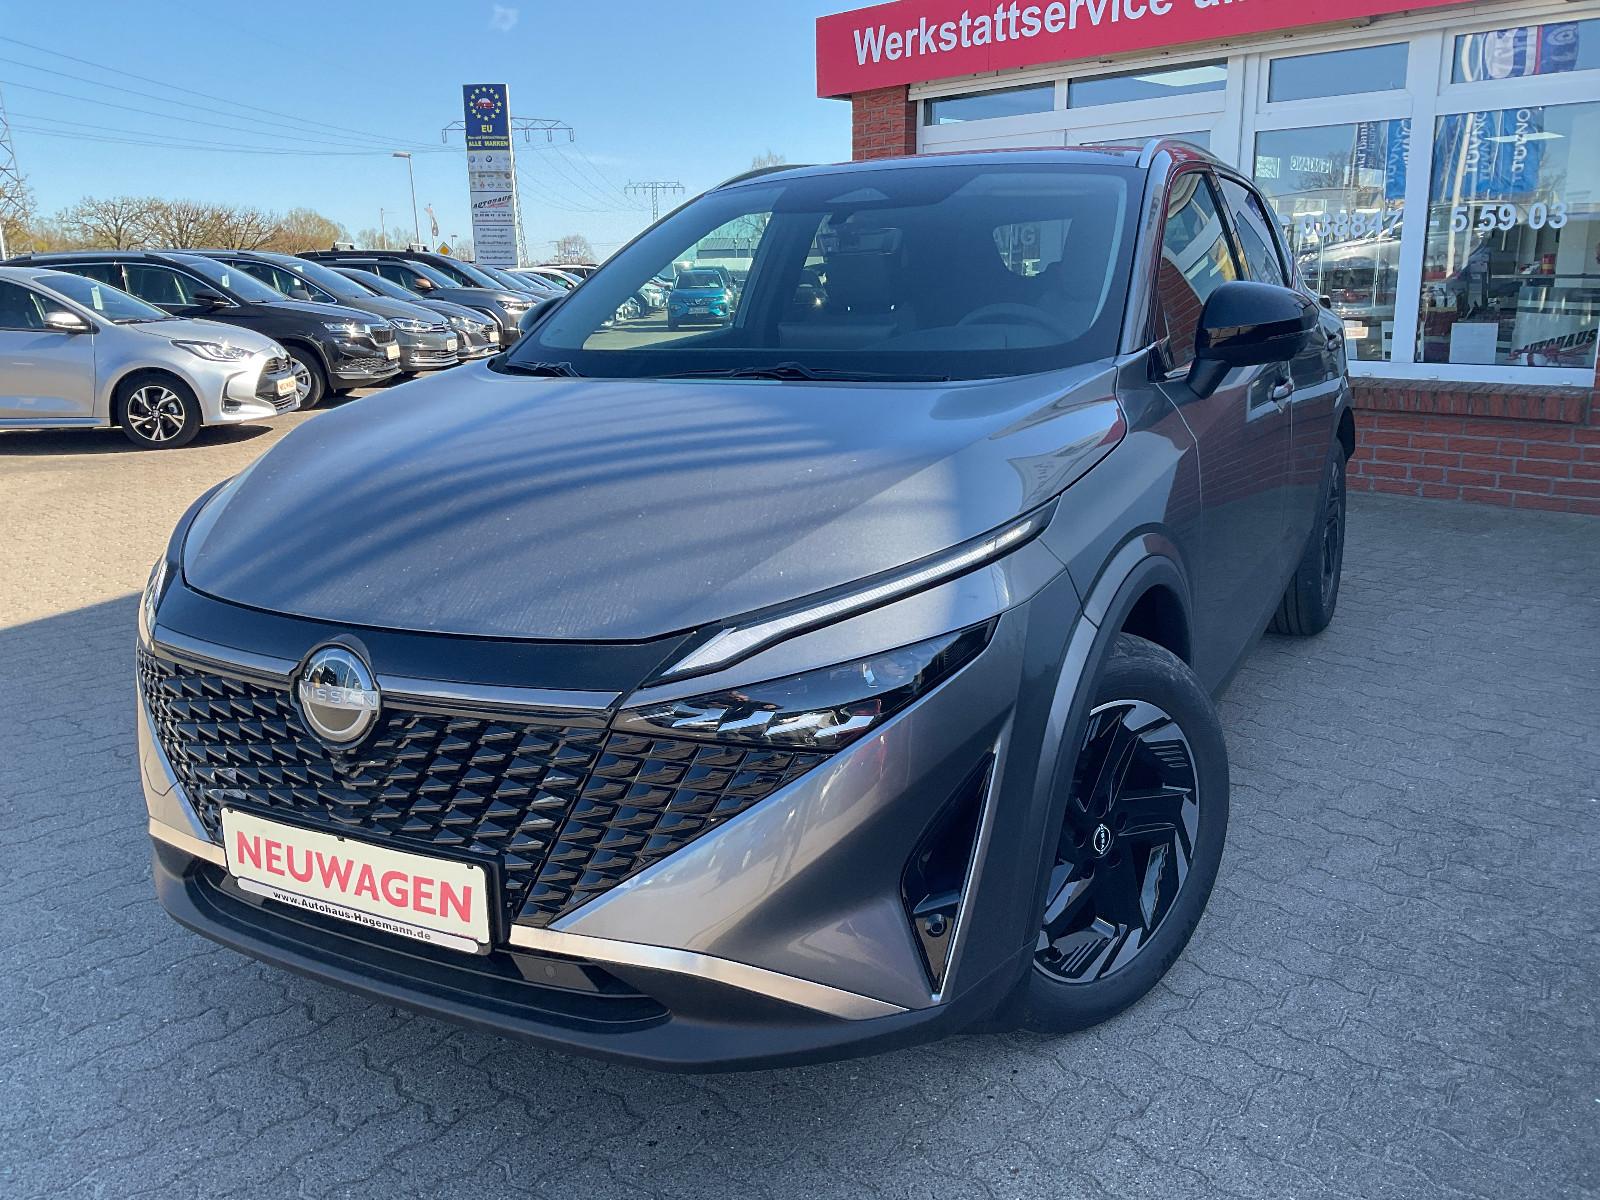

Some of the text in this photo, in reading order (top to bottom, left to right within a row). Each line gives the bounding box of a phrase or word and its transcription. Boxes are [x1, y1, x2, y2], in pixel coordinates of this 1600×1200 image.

[481, 125, 493, 133] EU
[1452, 205, 1469, 232] 5
[1480, 203, 1517, 231] 59
[1528, 200, 1568, 230] 03
[237, 831, 472, 923] NEUWAGEN
[273, 890, 431, 941] www.Autohaus-Hagemann.de
